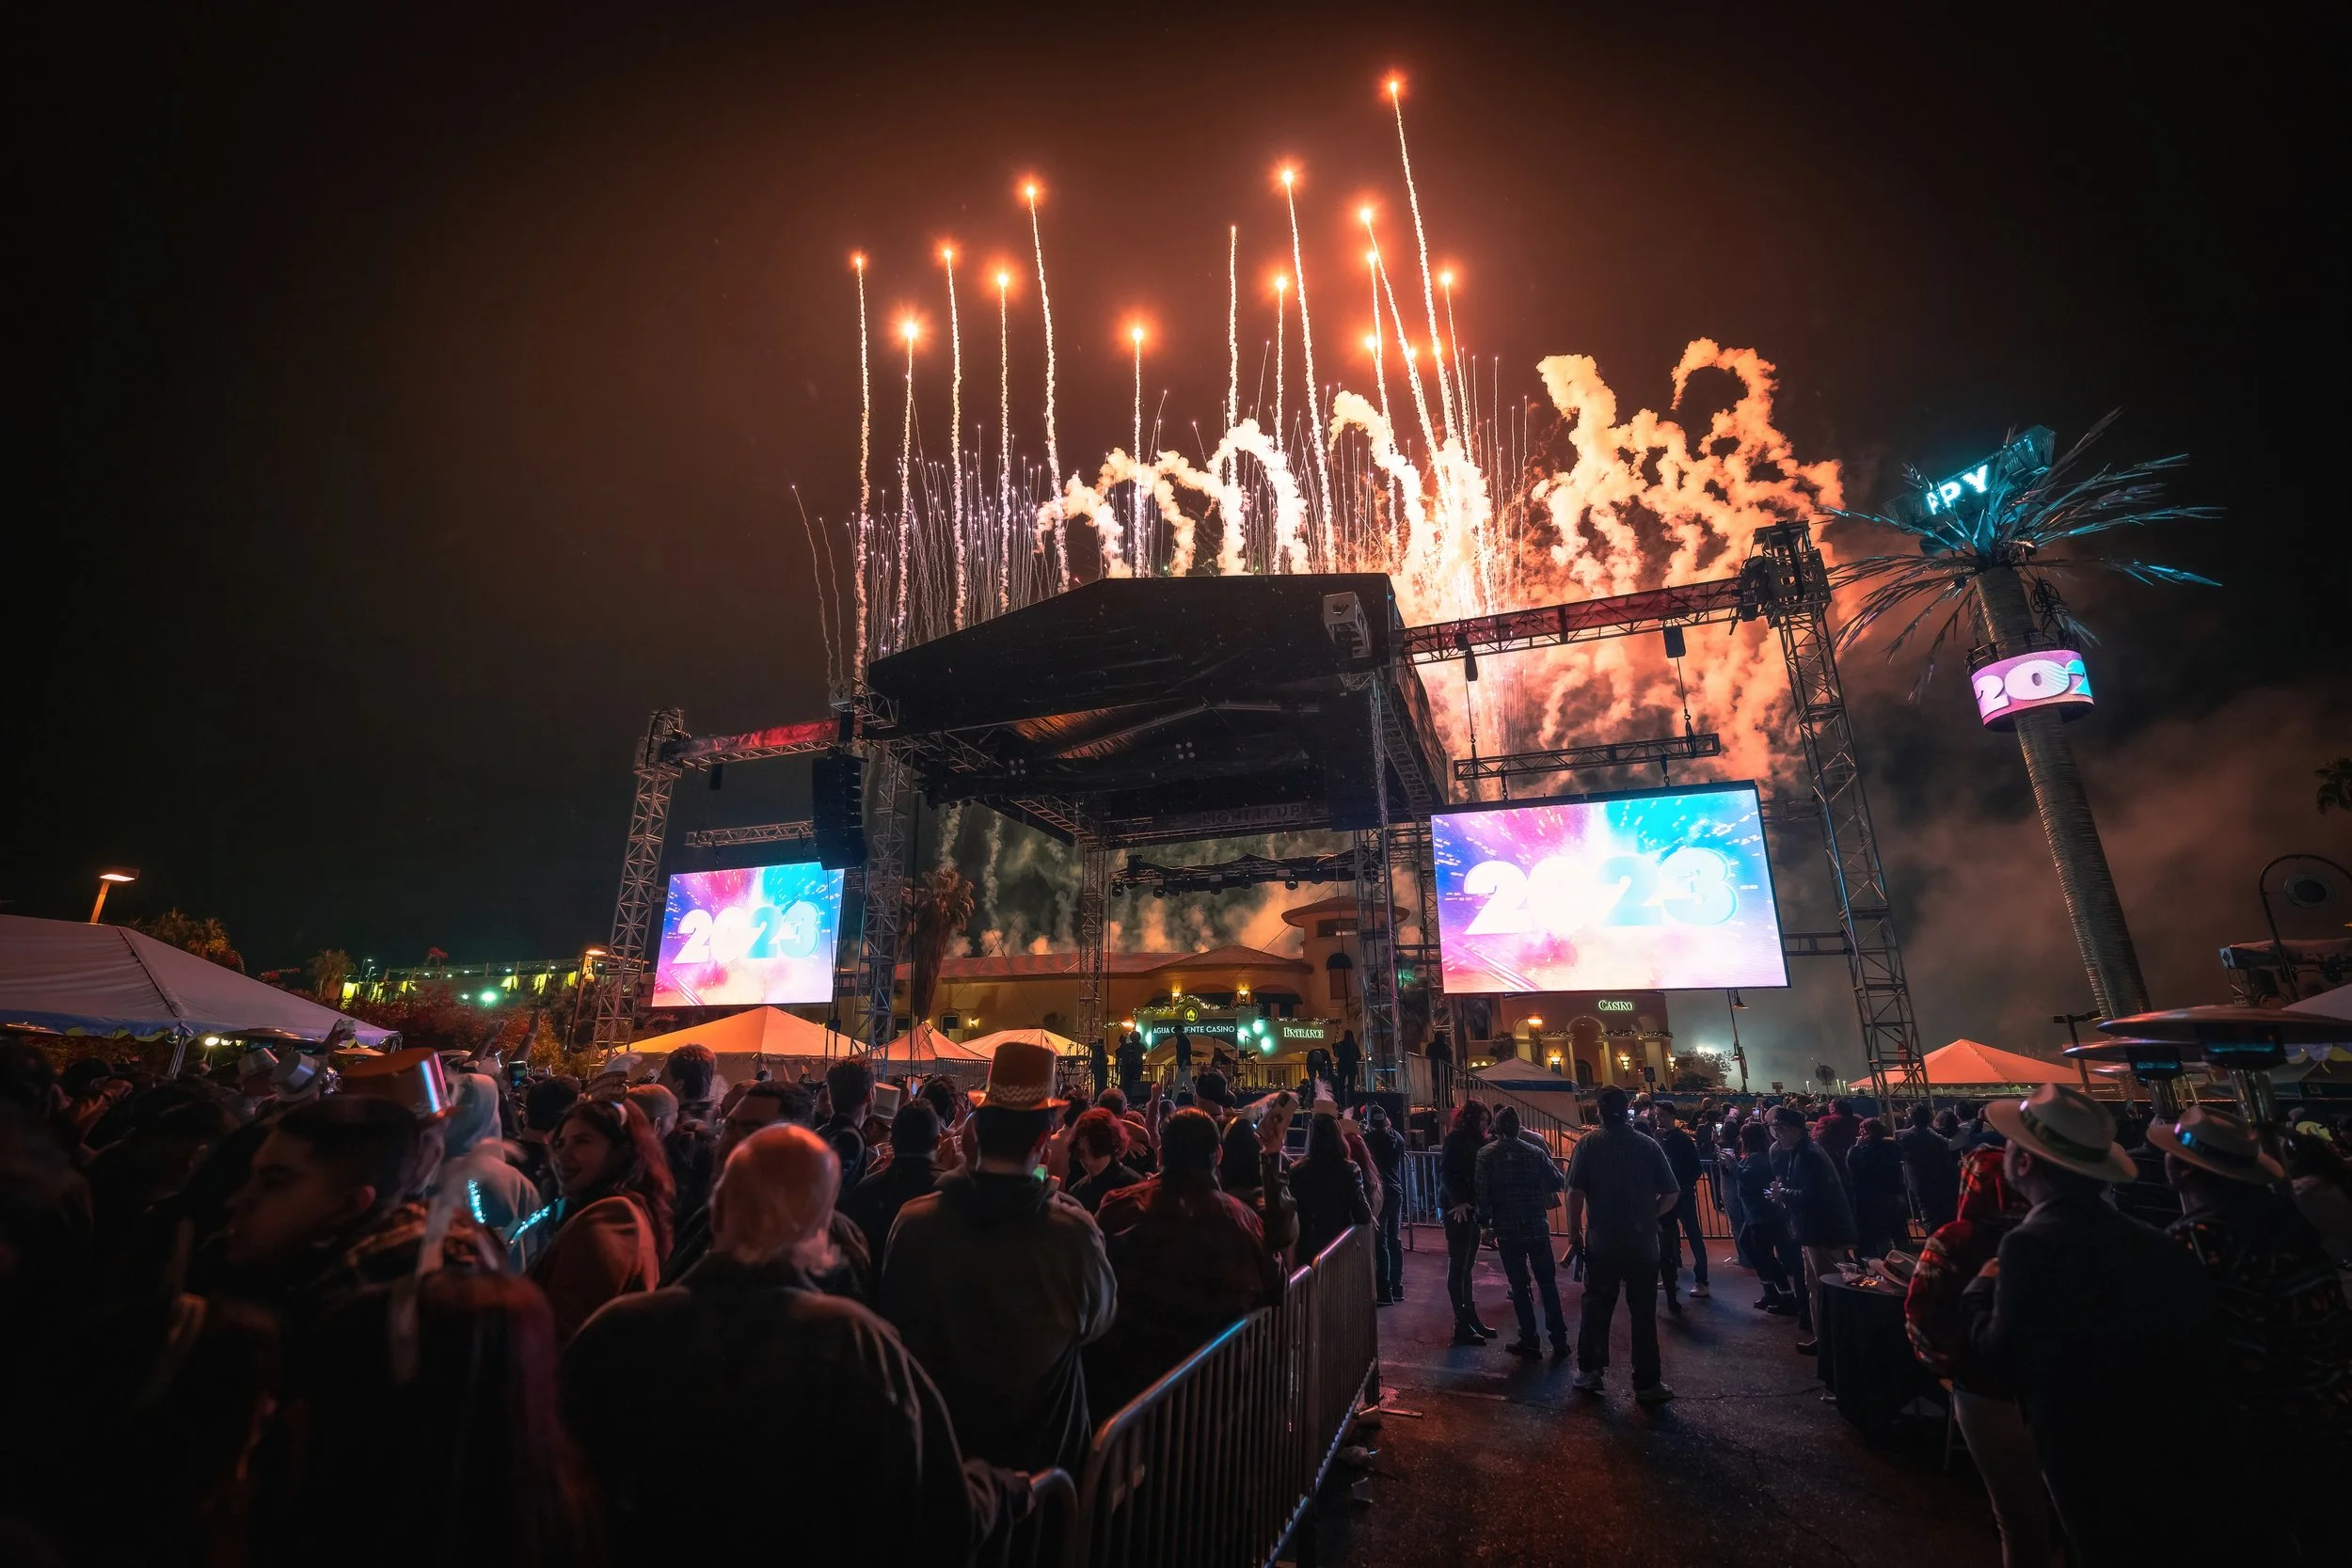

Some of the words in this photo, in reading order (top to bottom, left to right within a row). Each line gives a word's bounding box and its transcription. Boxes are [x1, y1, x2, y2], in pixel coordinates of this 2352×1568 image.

[1277, 804, 1301, 818] UP
[1463, 847, 1740, 936] 2023
[671, 900, 821, 965] 2023
[1597, 999, 1635, 1011] CASINO
[1152, 1026, 1170, 1035] AGUA
[1170, 1025, 1205, 1034] CIENTE
[1205, 1025, 1236, 1034] CASINO
[1282, 1026, 1325, 1039] ENTRANCE
